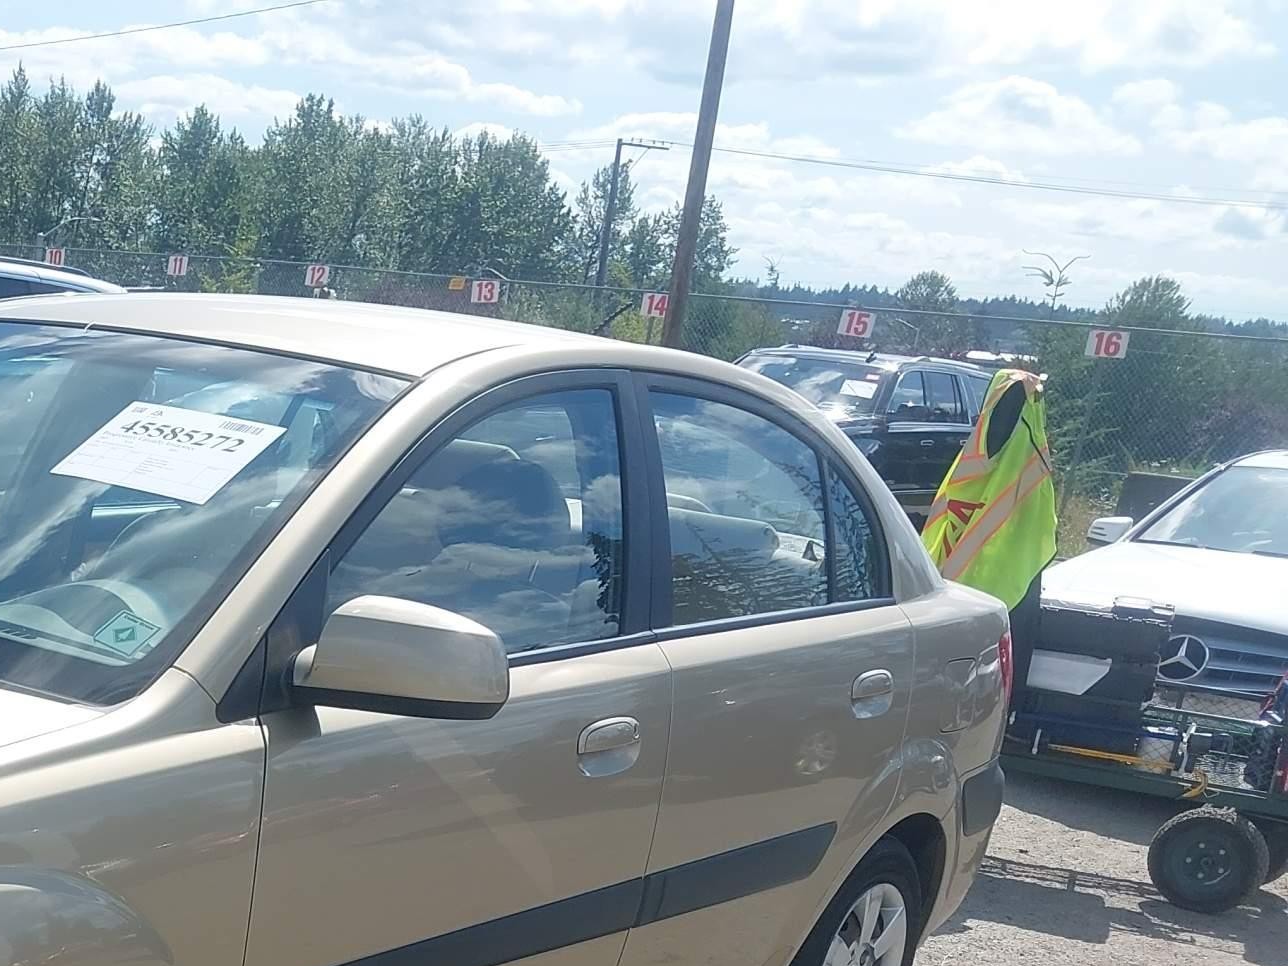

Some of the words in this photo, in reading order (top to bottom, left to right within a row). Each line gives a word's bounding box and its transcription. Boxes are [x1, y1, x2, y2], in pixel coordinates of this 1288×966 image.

[48, 249, 62, 265] 10
[173, 256, 183, 275] 11
[310, 266, 327, 285] 12
[476, 282, 494, 301] 13
[647, 294, 668, 316] 14
[845, 311, 871, 336] 15
[1094, 332, 1122, 357] 16
[120, 419, 245, 453] 45585272
